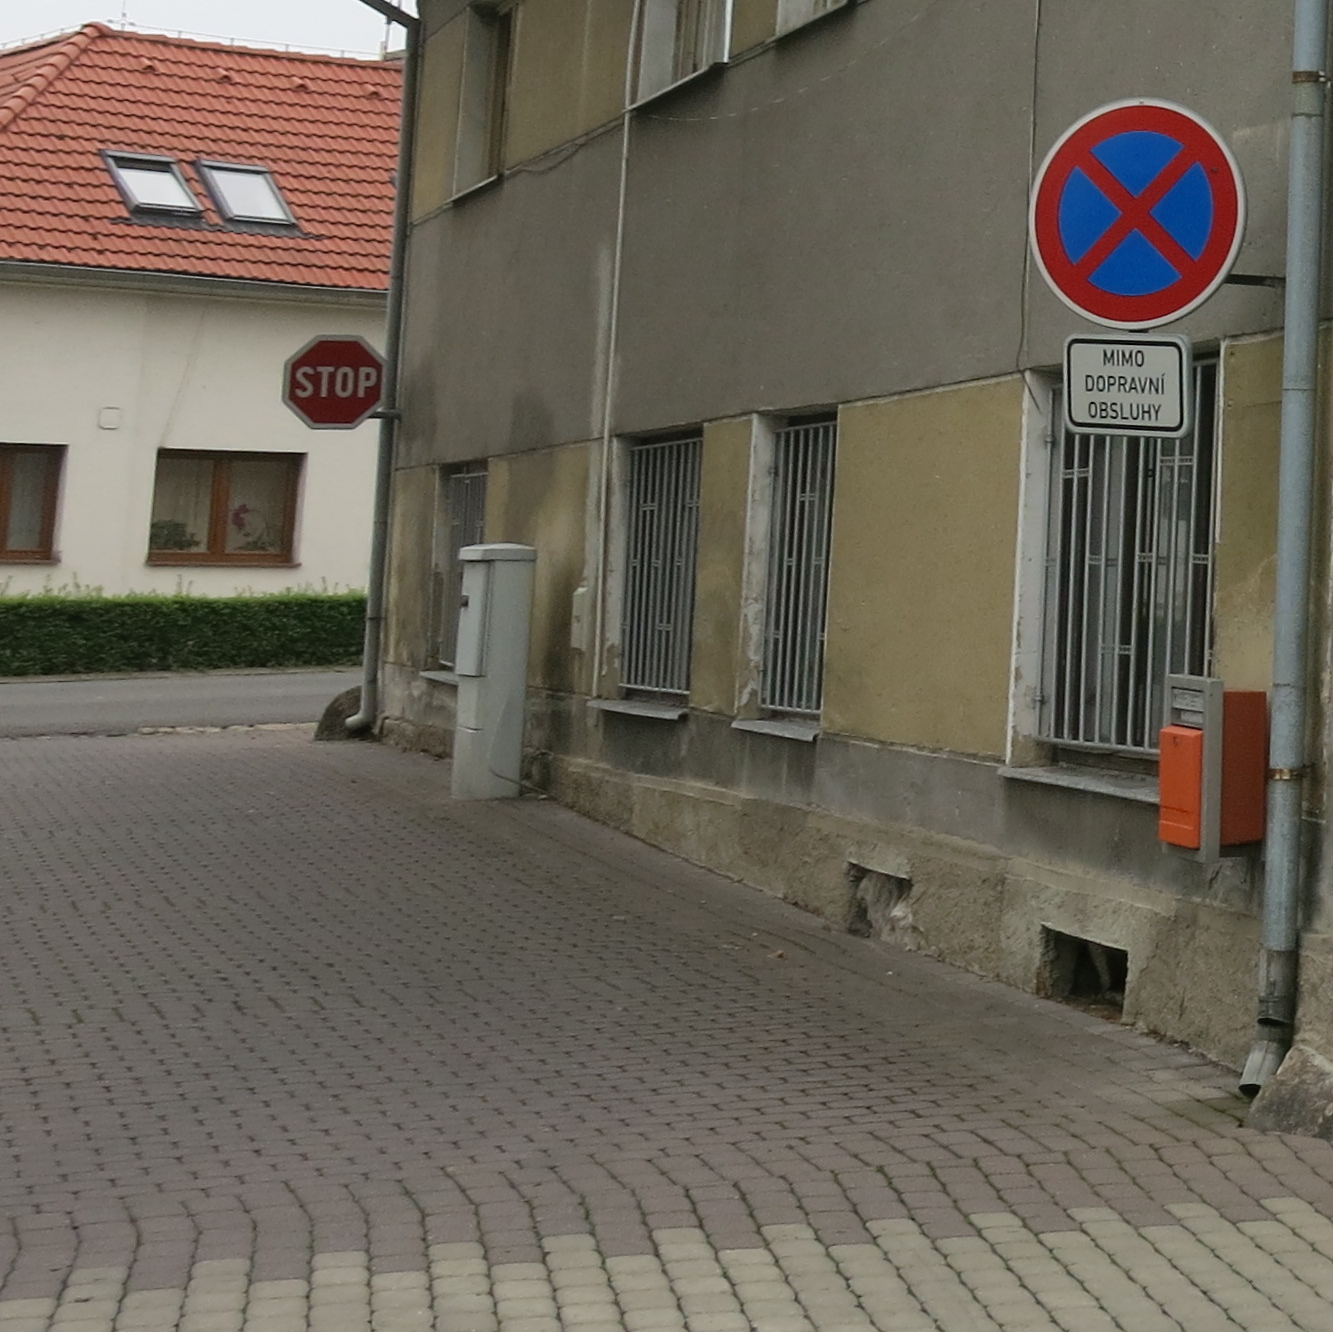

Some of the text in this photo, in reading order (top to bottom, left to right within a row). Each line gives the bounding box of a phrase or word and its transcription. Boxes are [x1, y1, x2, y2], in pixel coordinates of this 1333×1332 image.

[1103, 349, 1145, 367] MIMO
[294, 365, 377, 398] STOP
[1085, 372, 1166, 395] DOPRAVNÍ
[1088, 401, 1161, 421] OBSLUHY
